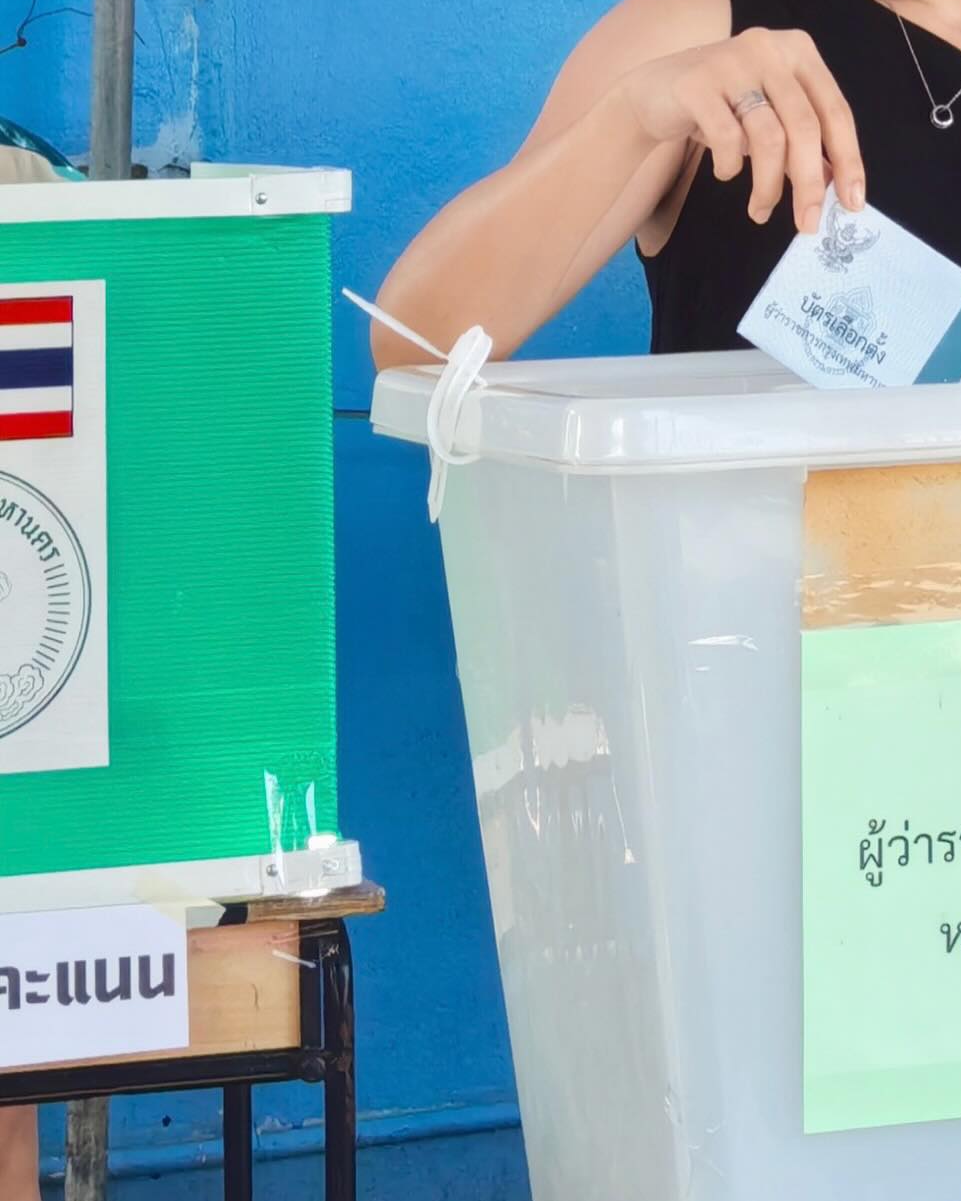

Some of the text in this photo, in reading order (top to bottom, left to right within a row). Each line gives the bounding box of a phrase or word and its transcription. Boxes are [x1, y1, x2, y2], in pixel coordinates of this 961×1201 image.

[800, 292, 888, 365] บัตรเลือกตั้ง
